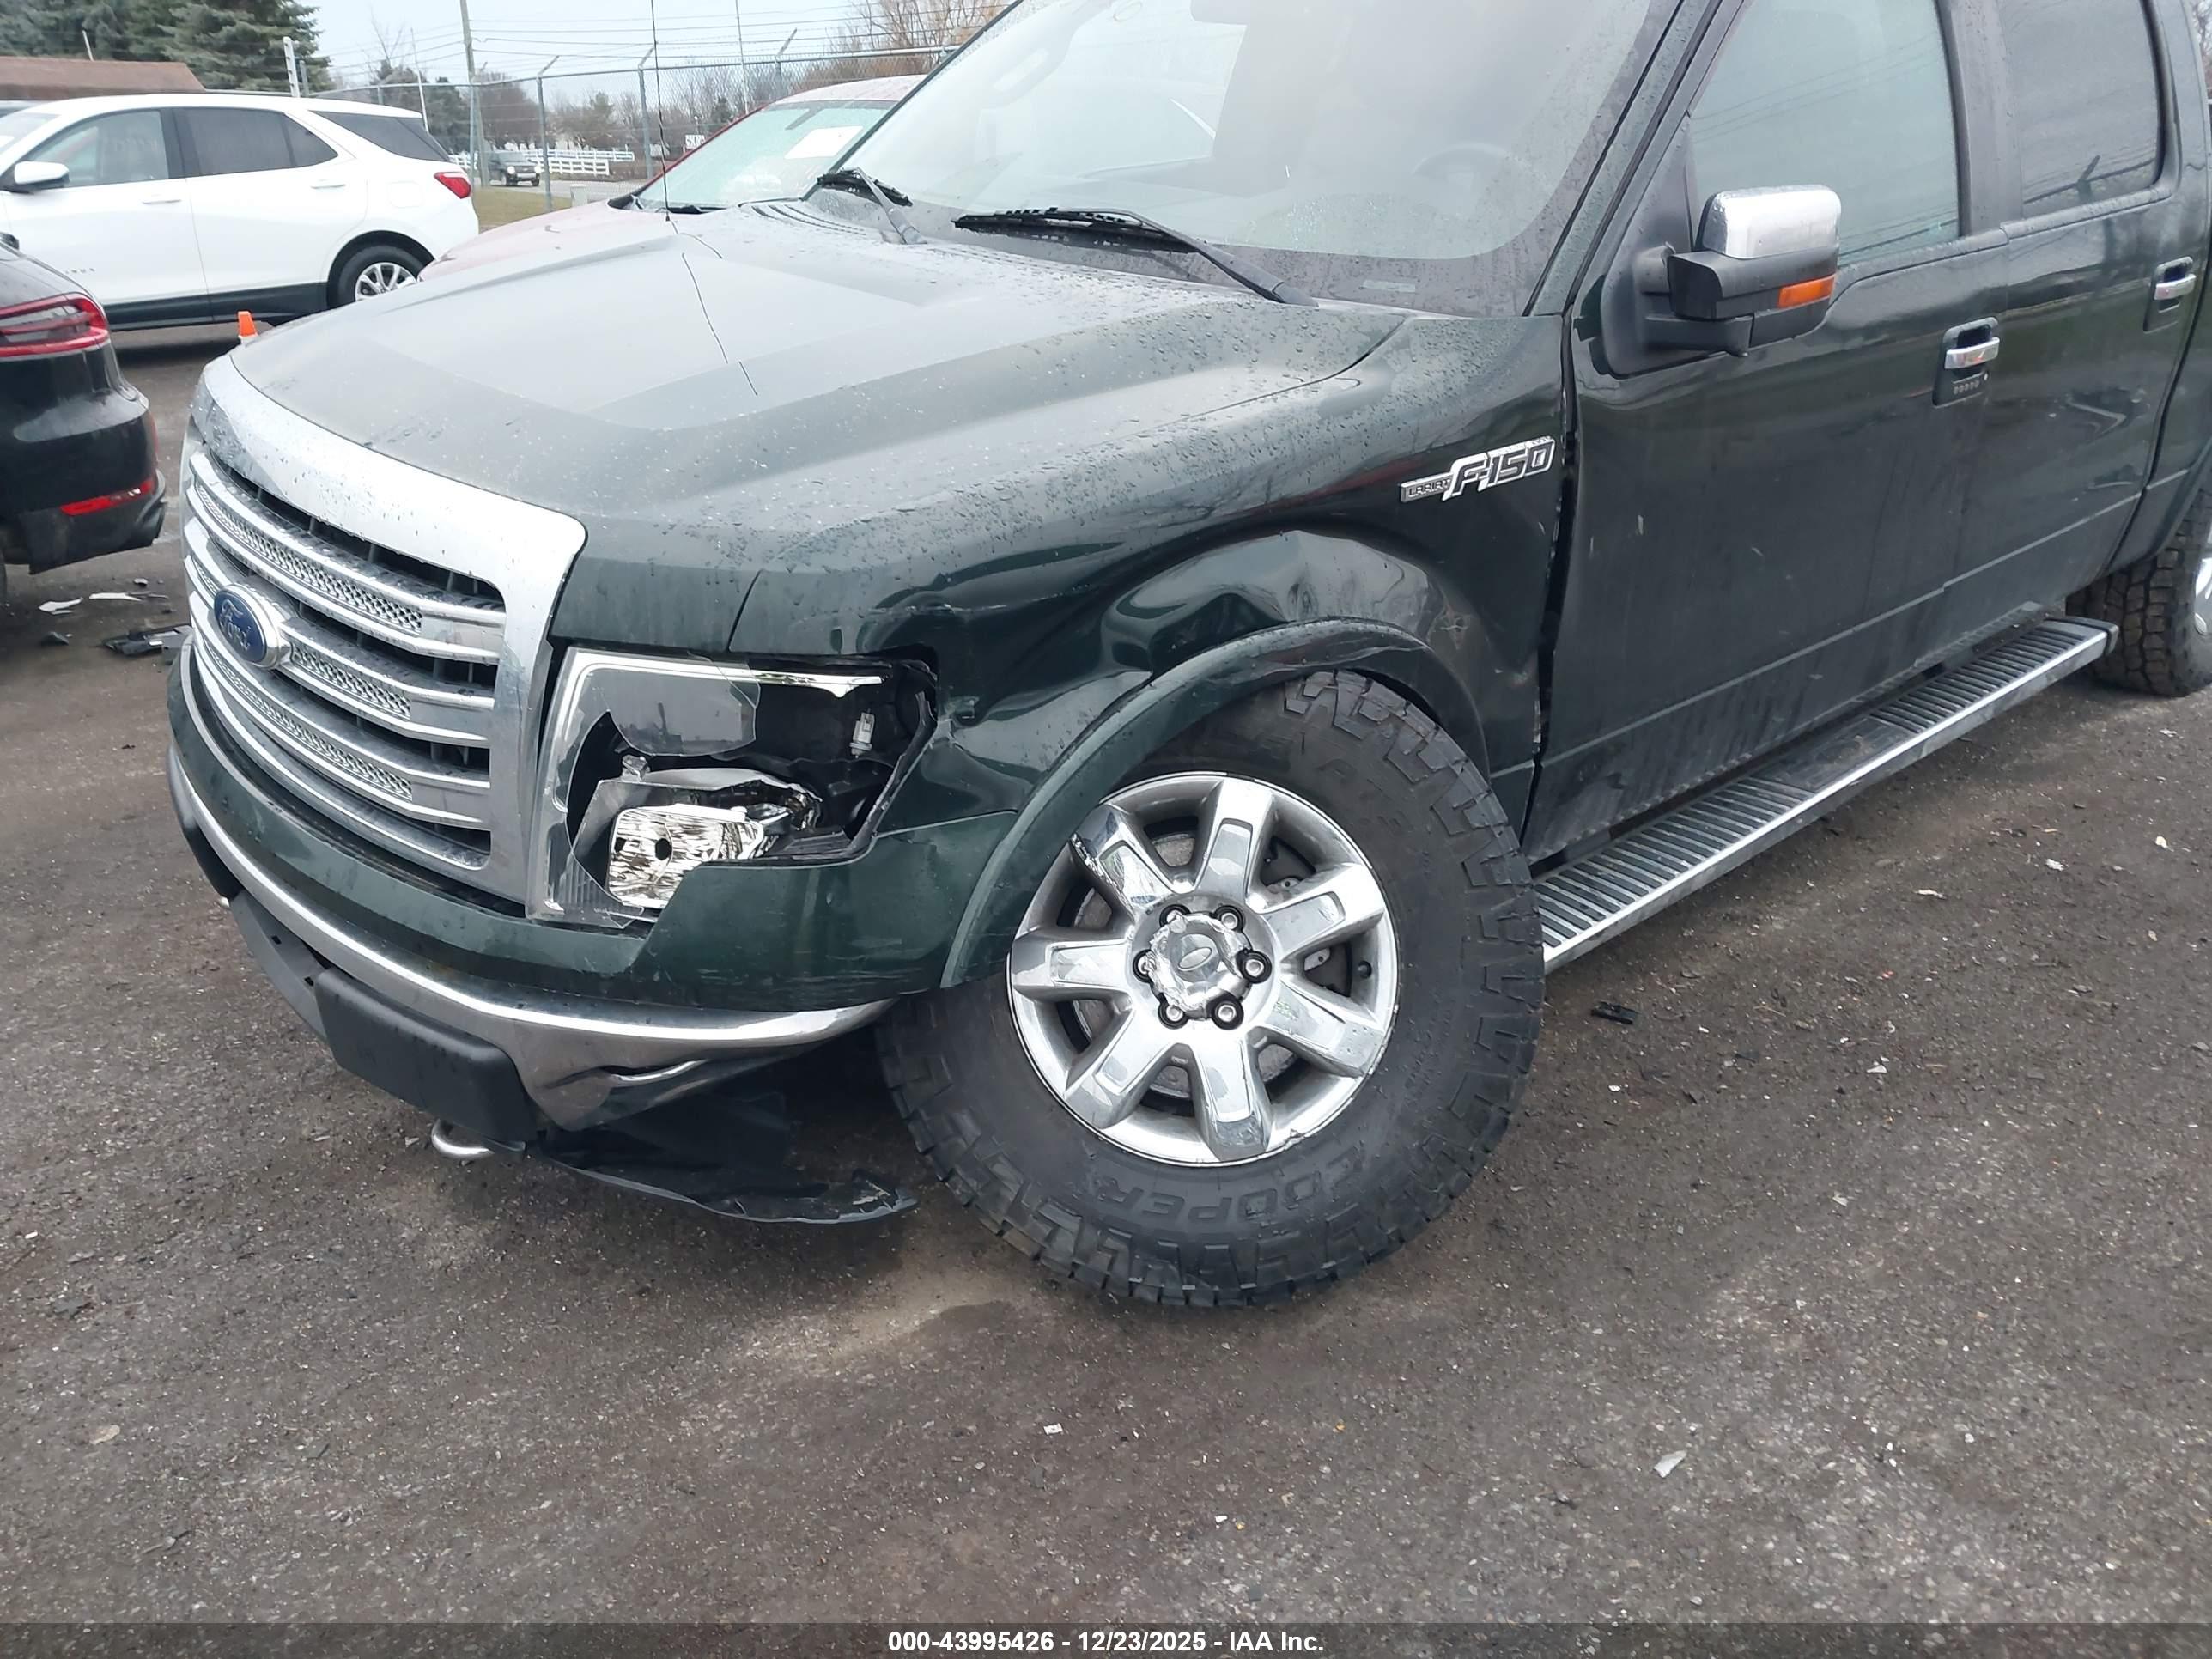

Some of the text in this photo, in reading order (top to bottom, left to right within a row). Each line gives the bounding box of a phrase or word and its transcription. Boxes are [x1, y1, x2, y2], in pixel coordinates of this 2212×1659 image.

[1407, 435, 1556, 502] LARIAT F-150
[218, 598, 252, 652] Ford
